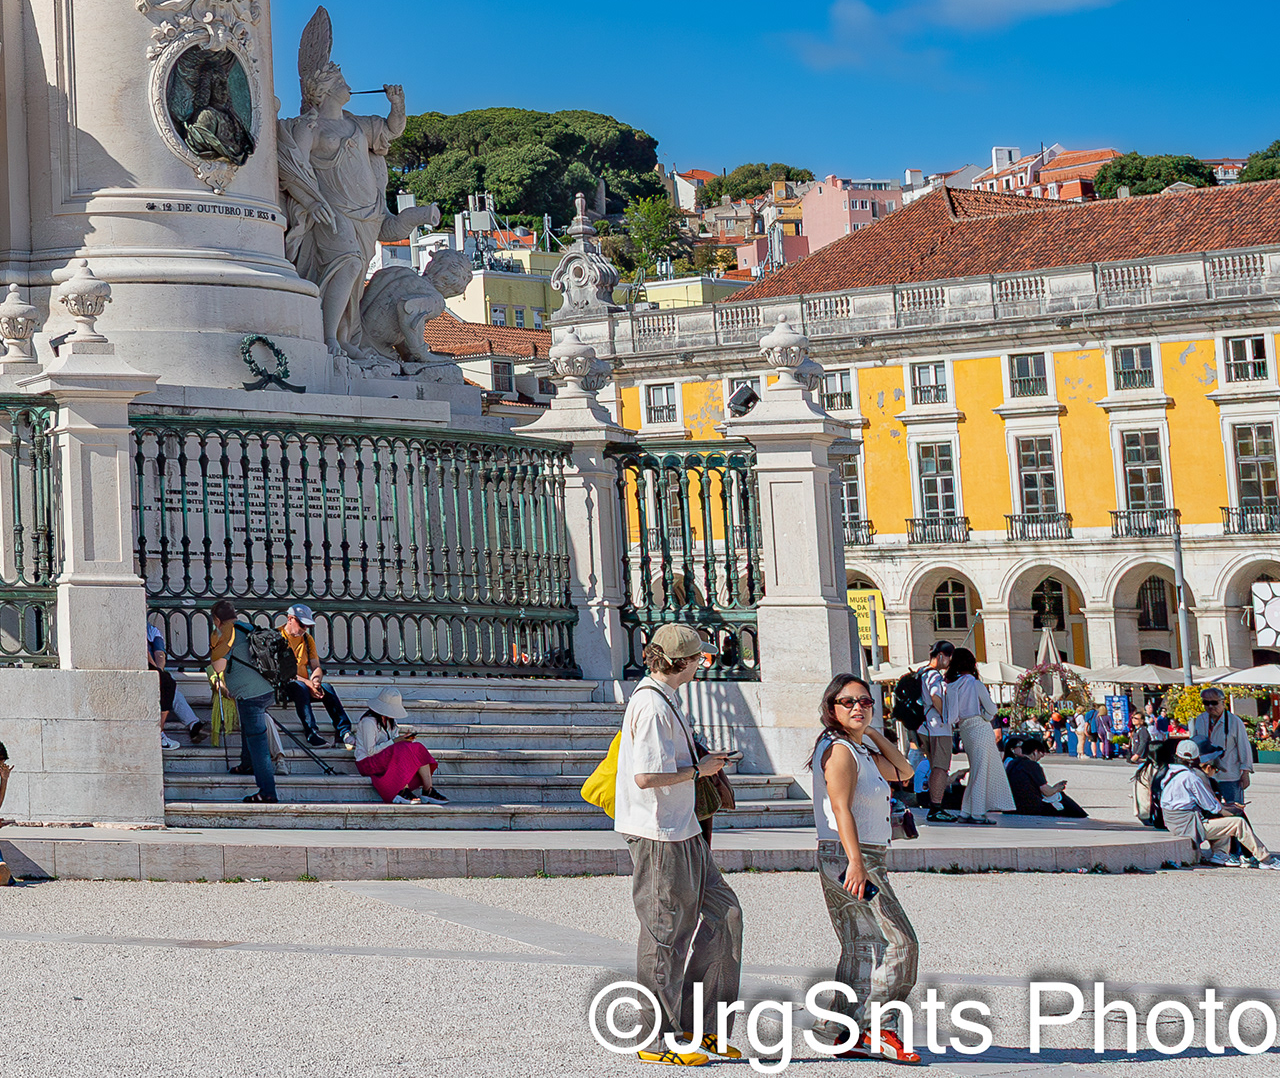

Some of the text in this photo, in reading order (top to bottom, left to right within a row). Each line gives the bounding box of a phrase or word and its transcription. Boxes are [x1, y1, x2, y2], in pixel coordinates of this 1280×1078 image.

[162, 203, 172, 211] 12
[177, 203, 192, 212] DE
[197, 204, 241, 216] OUTUBRO
[244, 208, 254, 218] DE
